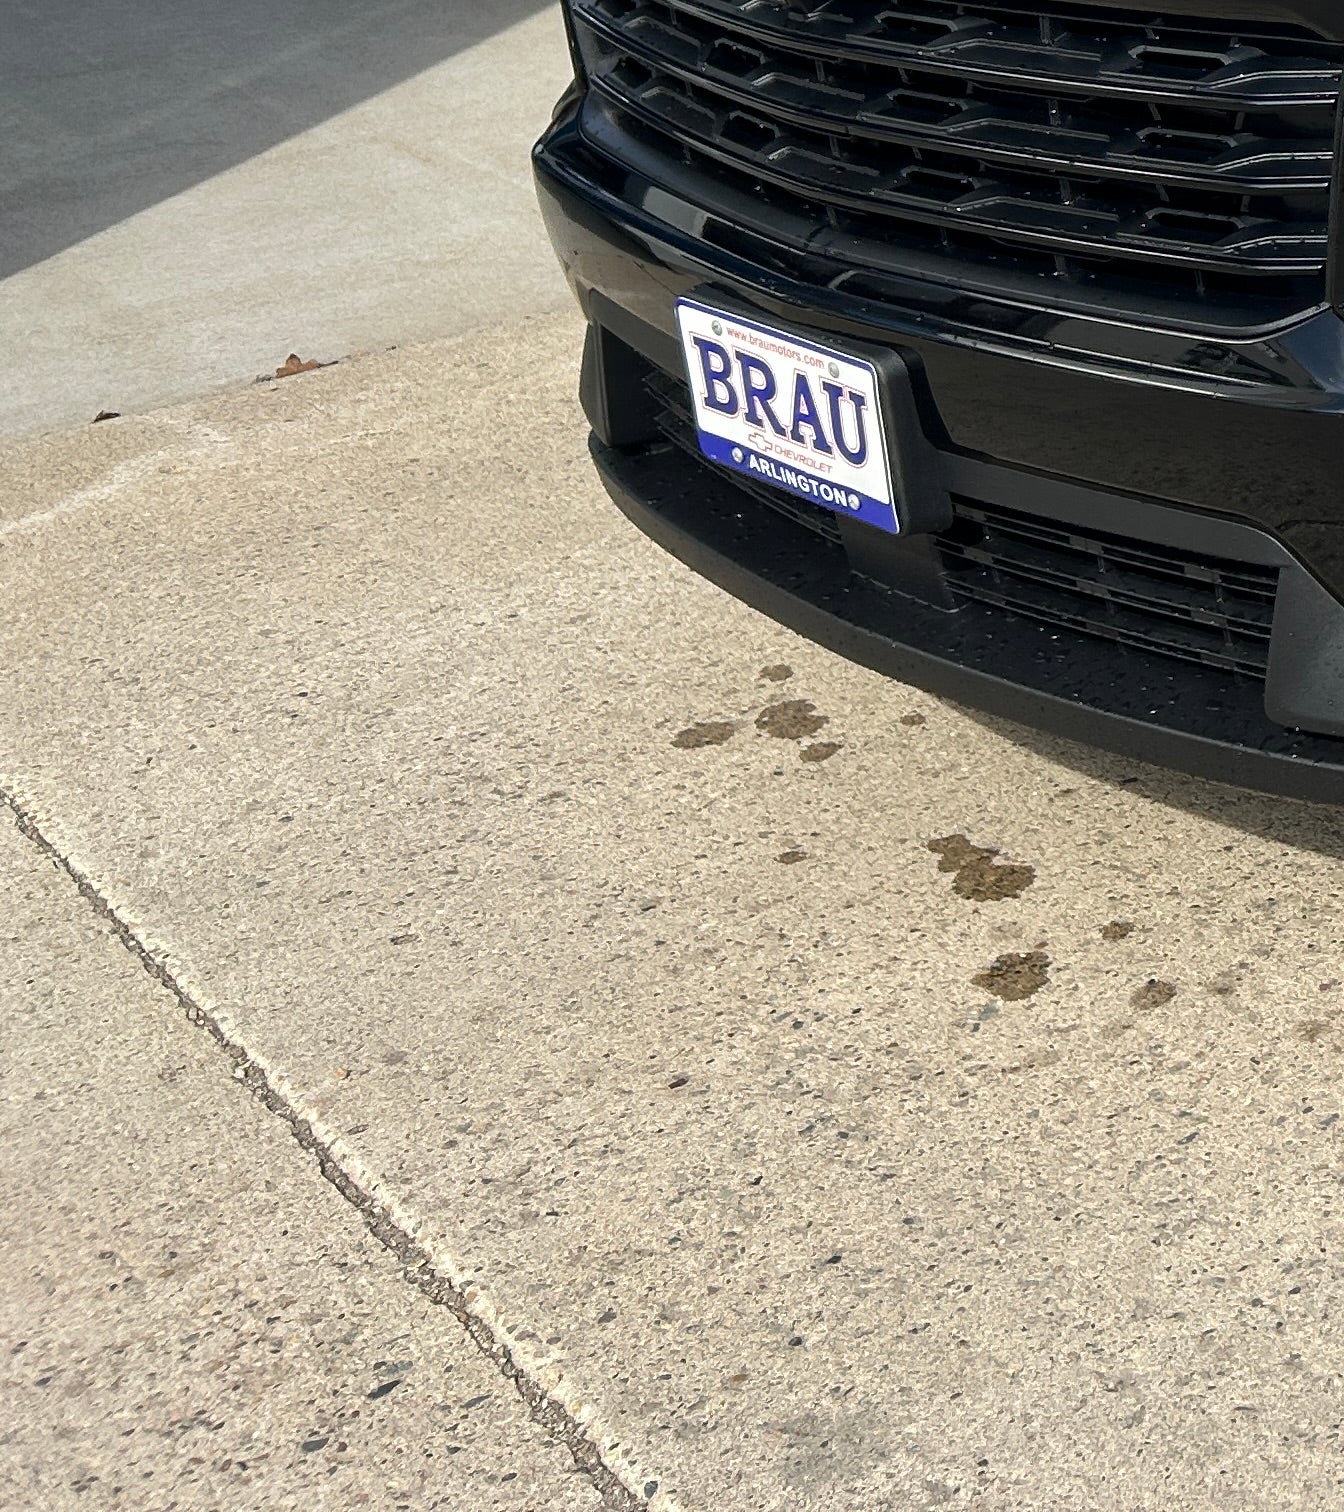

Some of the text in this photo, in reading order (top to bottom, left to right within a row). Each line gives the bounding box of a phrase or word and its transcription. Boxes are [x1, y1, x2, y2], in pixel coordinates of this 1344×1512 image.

[726, 326, 826, 370] www.braumotors.com
[690, 333, 869, 468] BRAU
[748, 451, 849, 508] ARLINGTON
[772, 443, 834, 475] CHEVROLET
